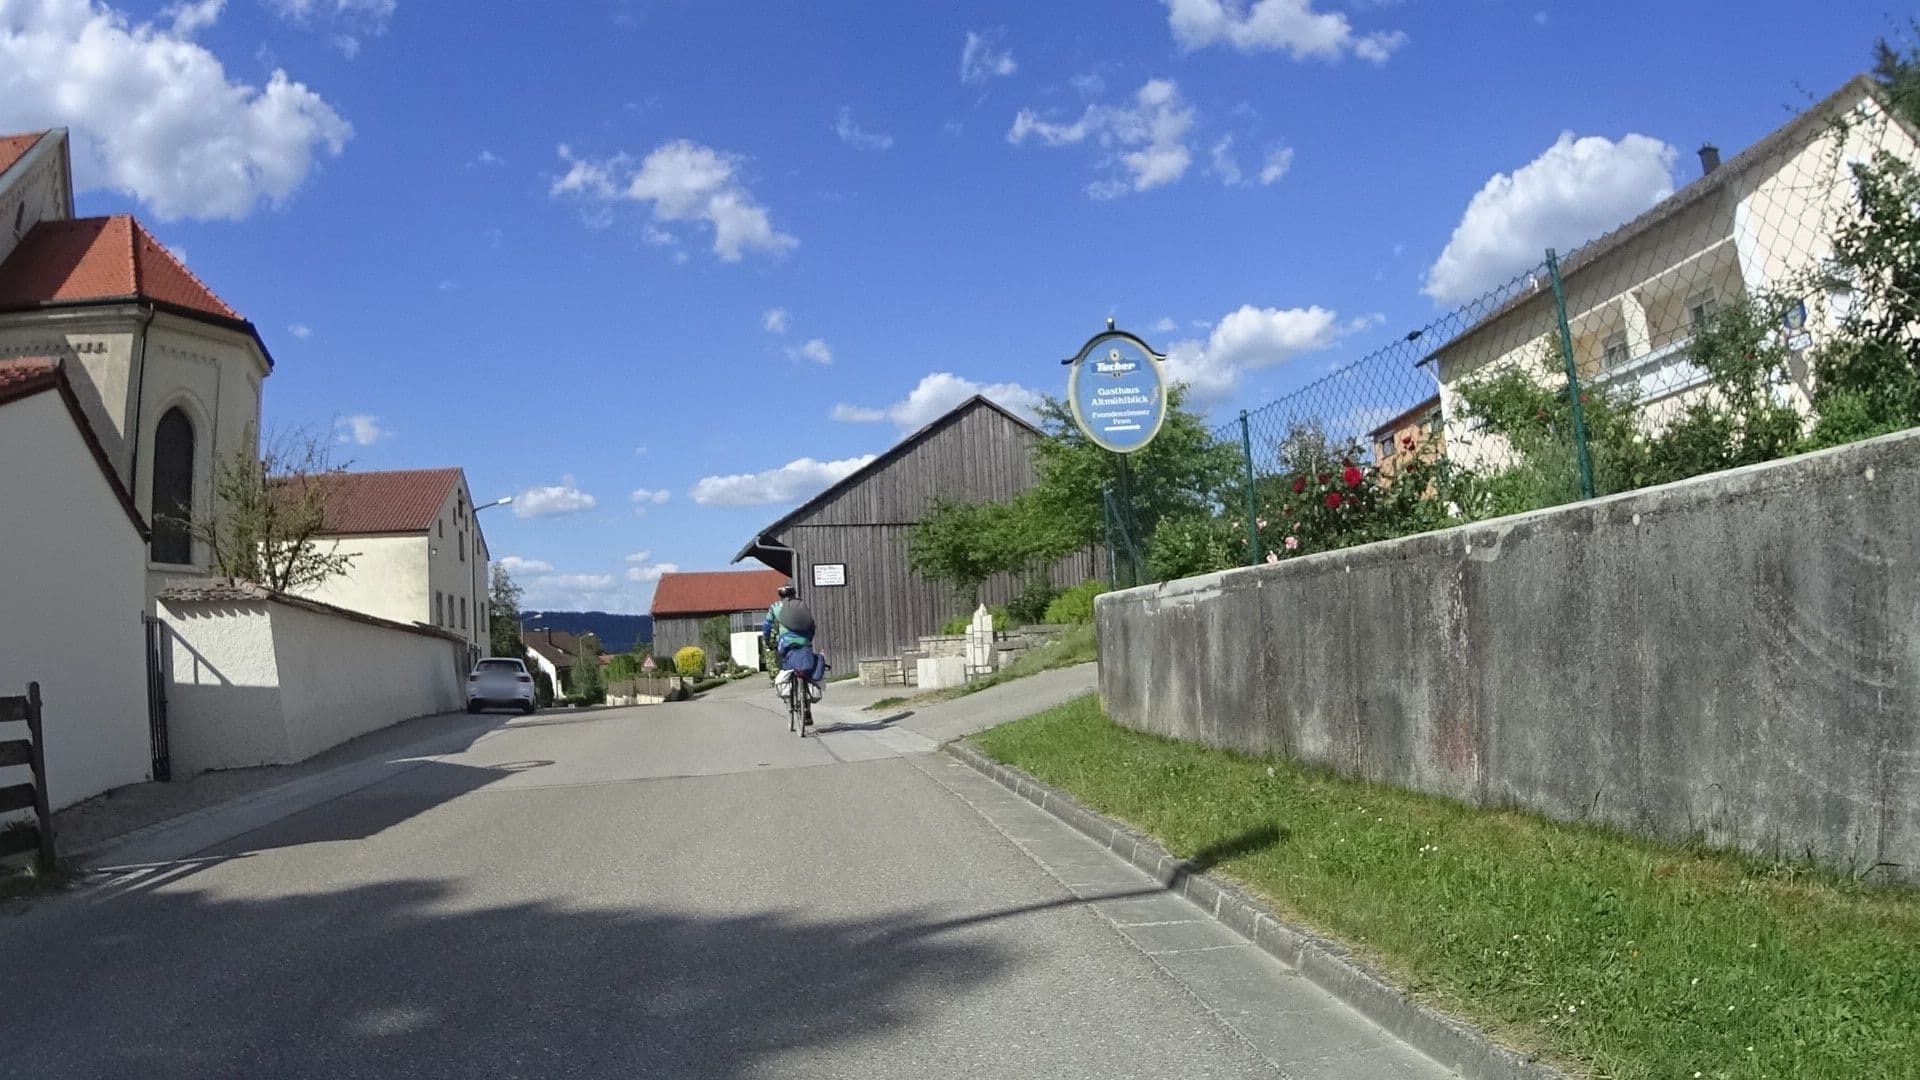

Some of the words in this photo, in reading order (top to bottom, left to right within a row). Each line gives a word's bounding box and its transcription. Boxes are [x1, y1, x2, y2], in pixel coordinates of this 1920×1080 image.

[1096, 361, 1136, 372] Tucher
[1098, 387, 1140, 396] Gasthaus
[1091, 395, 1149, 406] Altmühlblick
